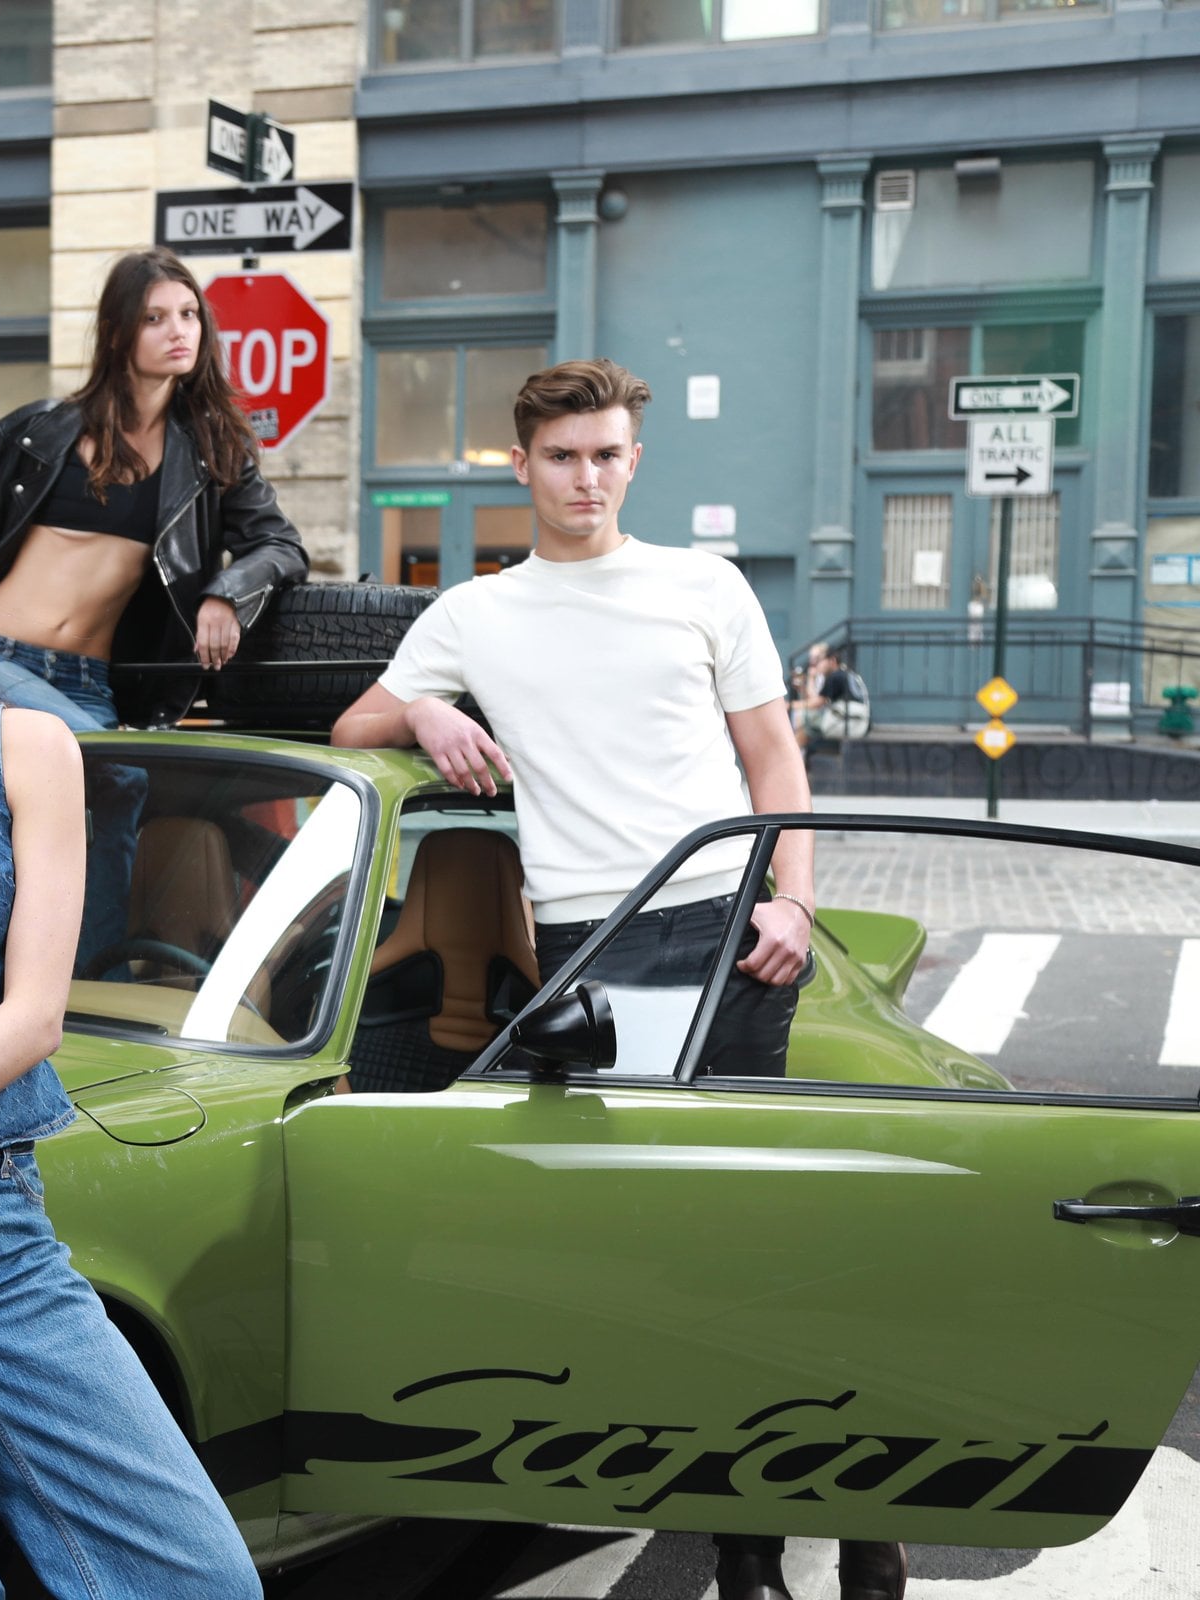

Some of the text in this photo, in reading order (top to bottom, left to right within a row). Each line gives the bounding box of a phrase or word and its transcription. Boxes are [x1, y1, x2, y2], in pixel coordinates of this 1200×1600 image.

[220, 126, 246, 158] ONE
[182, 206, 322, 236] ONE WAY
[217, 328, 318, 396] TOP
[971, 389, 1056, 406] ONE WAY
[990, 425, 1033, 442] ALL
[978, 447, 1044, 462] TRAFFIC
[305, 1368, 1109, 1514] Safari
